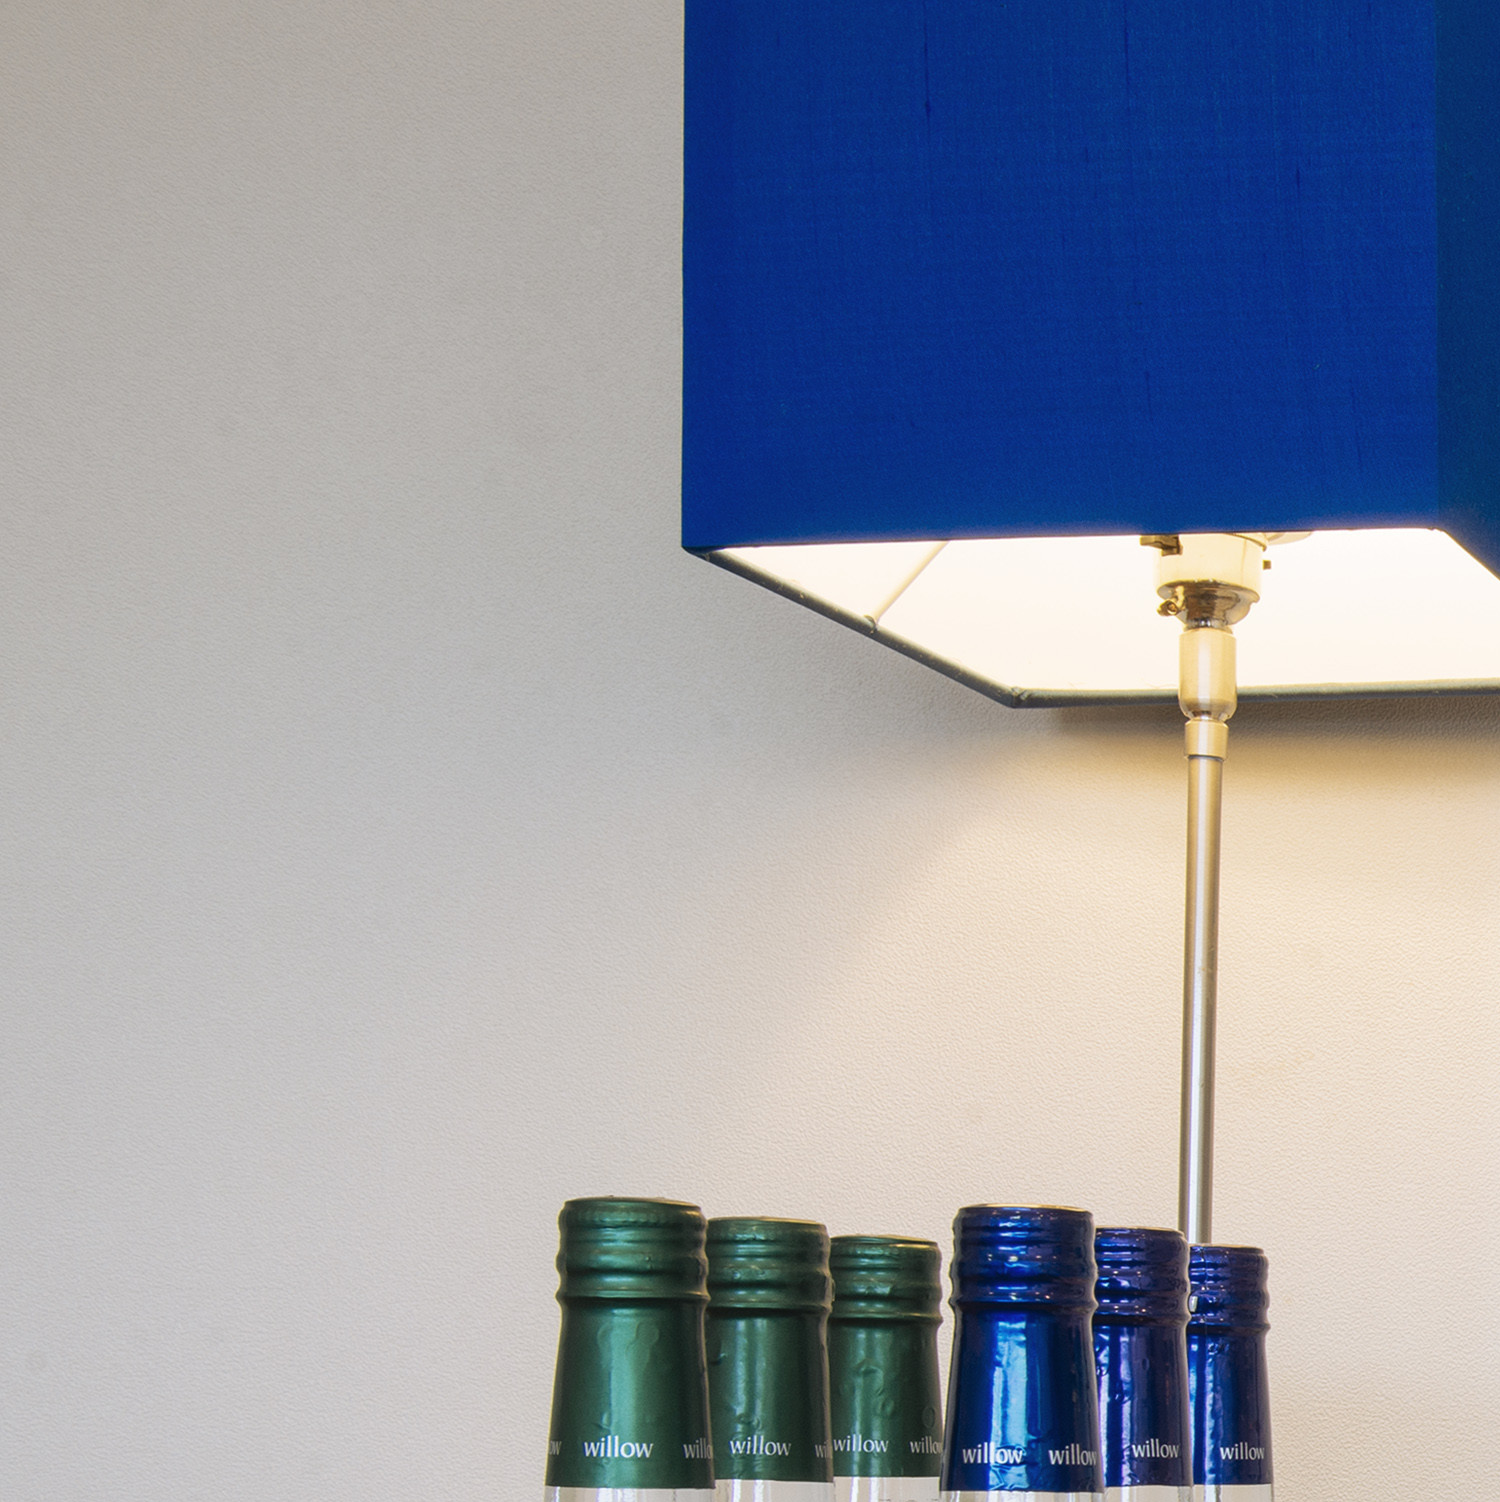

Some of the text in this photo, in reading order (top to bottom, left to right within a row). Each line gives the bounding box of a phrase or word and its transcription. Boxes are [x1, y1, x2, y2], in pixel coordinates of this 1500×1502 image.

[583, 1435, 653, 1458] willow
[682, 1437, 713, 1459] willo
[729, 1435, 791, 1457] willow
[833, 1434, 889, 1453] willow
[962, 1440, 1023, 1465] willow
[1048, 1443, 1097, 1466] willow
[1131, 1438, 1180, 1459] willow
[1220, 1441, 1265, 1461] willow
